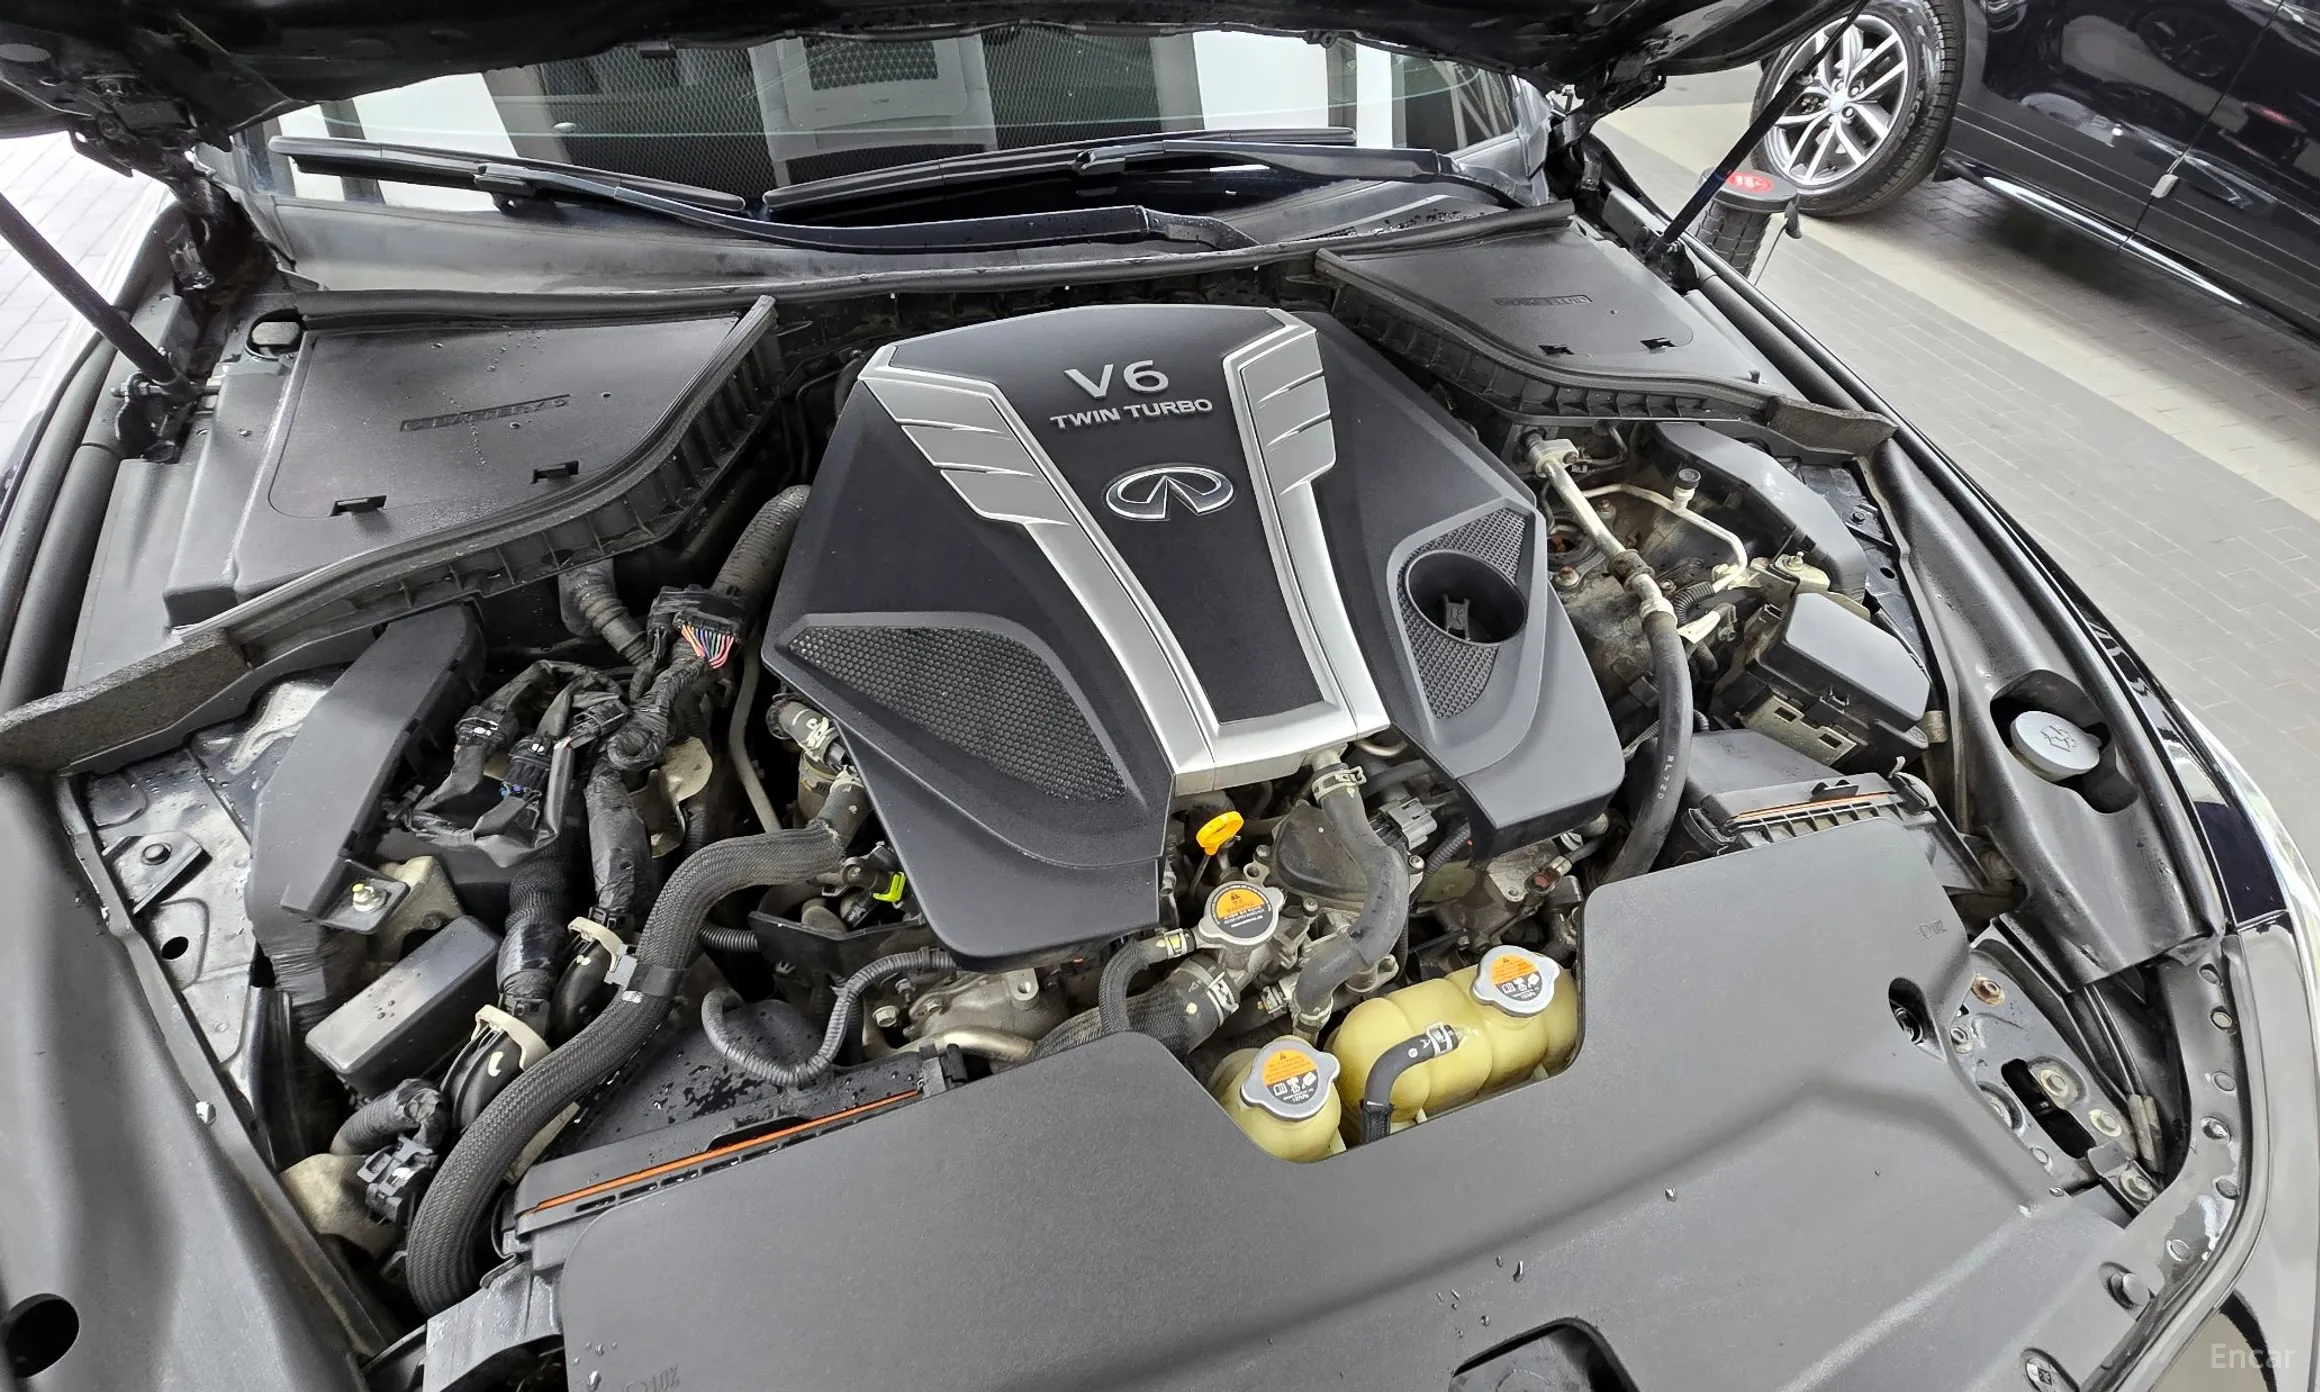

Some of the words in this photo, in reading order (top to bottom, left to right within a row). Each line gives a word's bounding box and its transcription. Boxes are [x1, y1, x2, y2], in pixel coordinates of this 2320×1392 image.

[1063, 359, 1169, 400] V6
[1049, 407, 1121, 430] TWIN
[1123, 398, 1213, 418] TURBO
